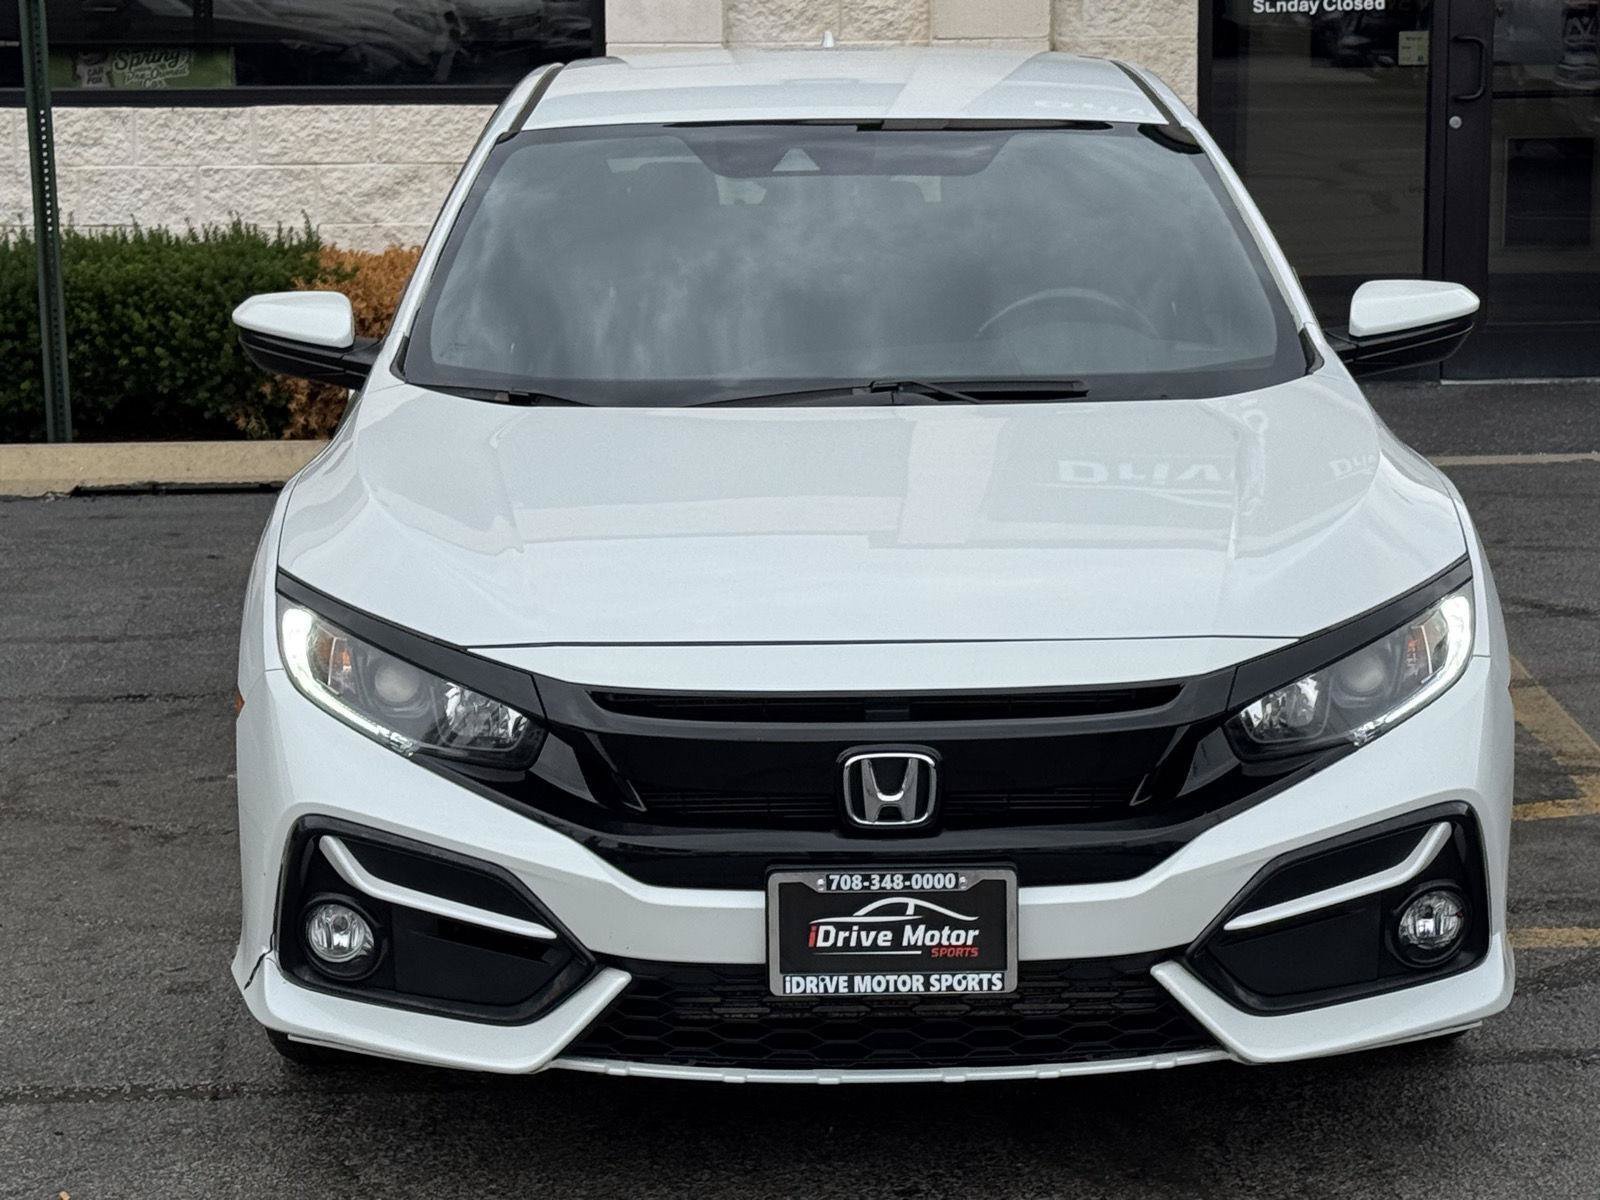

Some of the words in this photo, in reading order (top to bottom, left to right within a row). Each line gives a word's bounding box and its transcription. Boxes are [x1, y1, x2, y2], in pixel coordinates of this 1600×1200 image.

[1322, 0, 1386, 11] Closed
[115, 49, 180, 70] Spring
[87, 66, 104, 75] CAR
[87, 76, 103, 84] FOX
[829, 873, 956, 890] 708-348-0000
[808, 925, 893, 947] iDrive
[902, 924, 979, 946] Motor
[931, 947, 979, 958] SPORTS
[853, 974, 924, 993] MOTOR
[929, 973, 1003, 991] SPORTS
